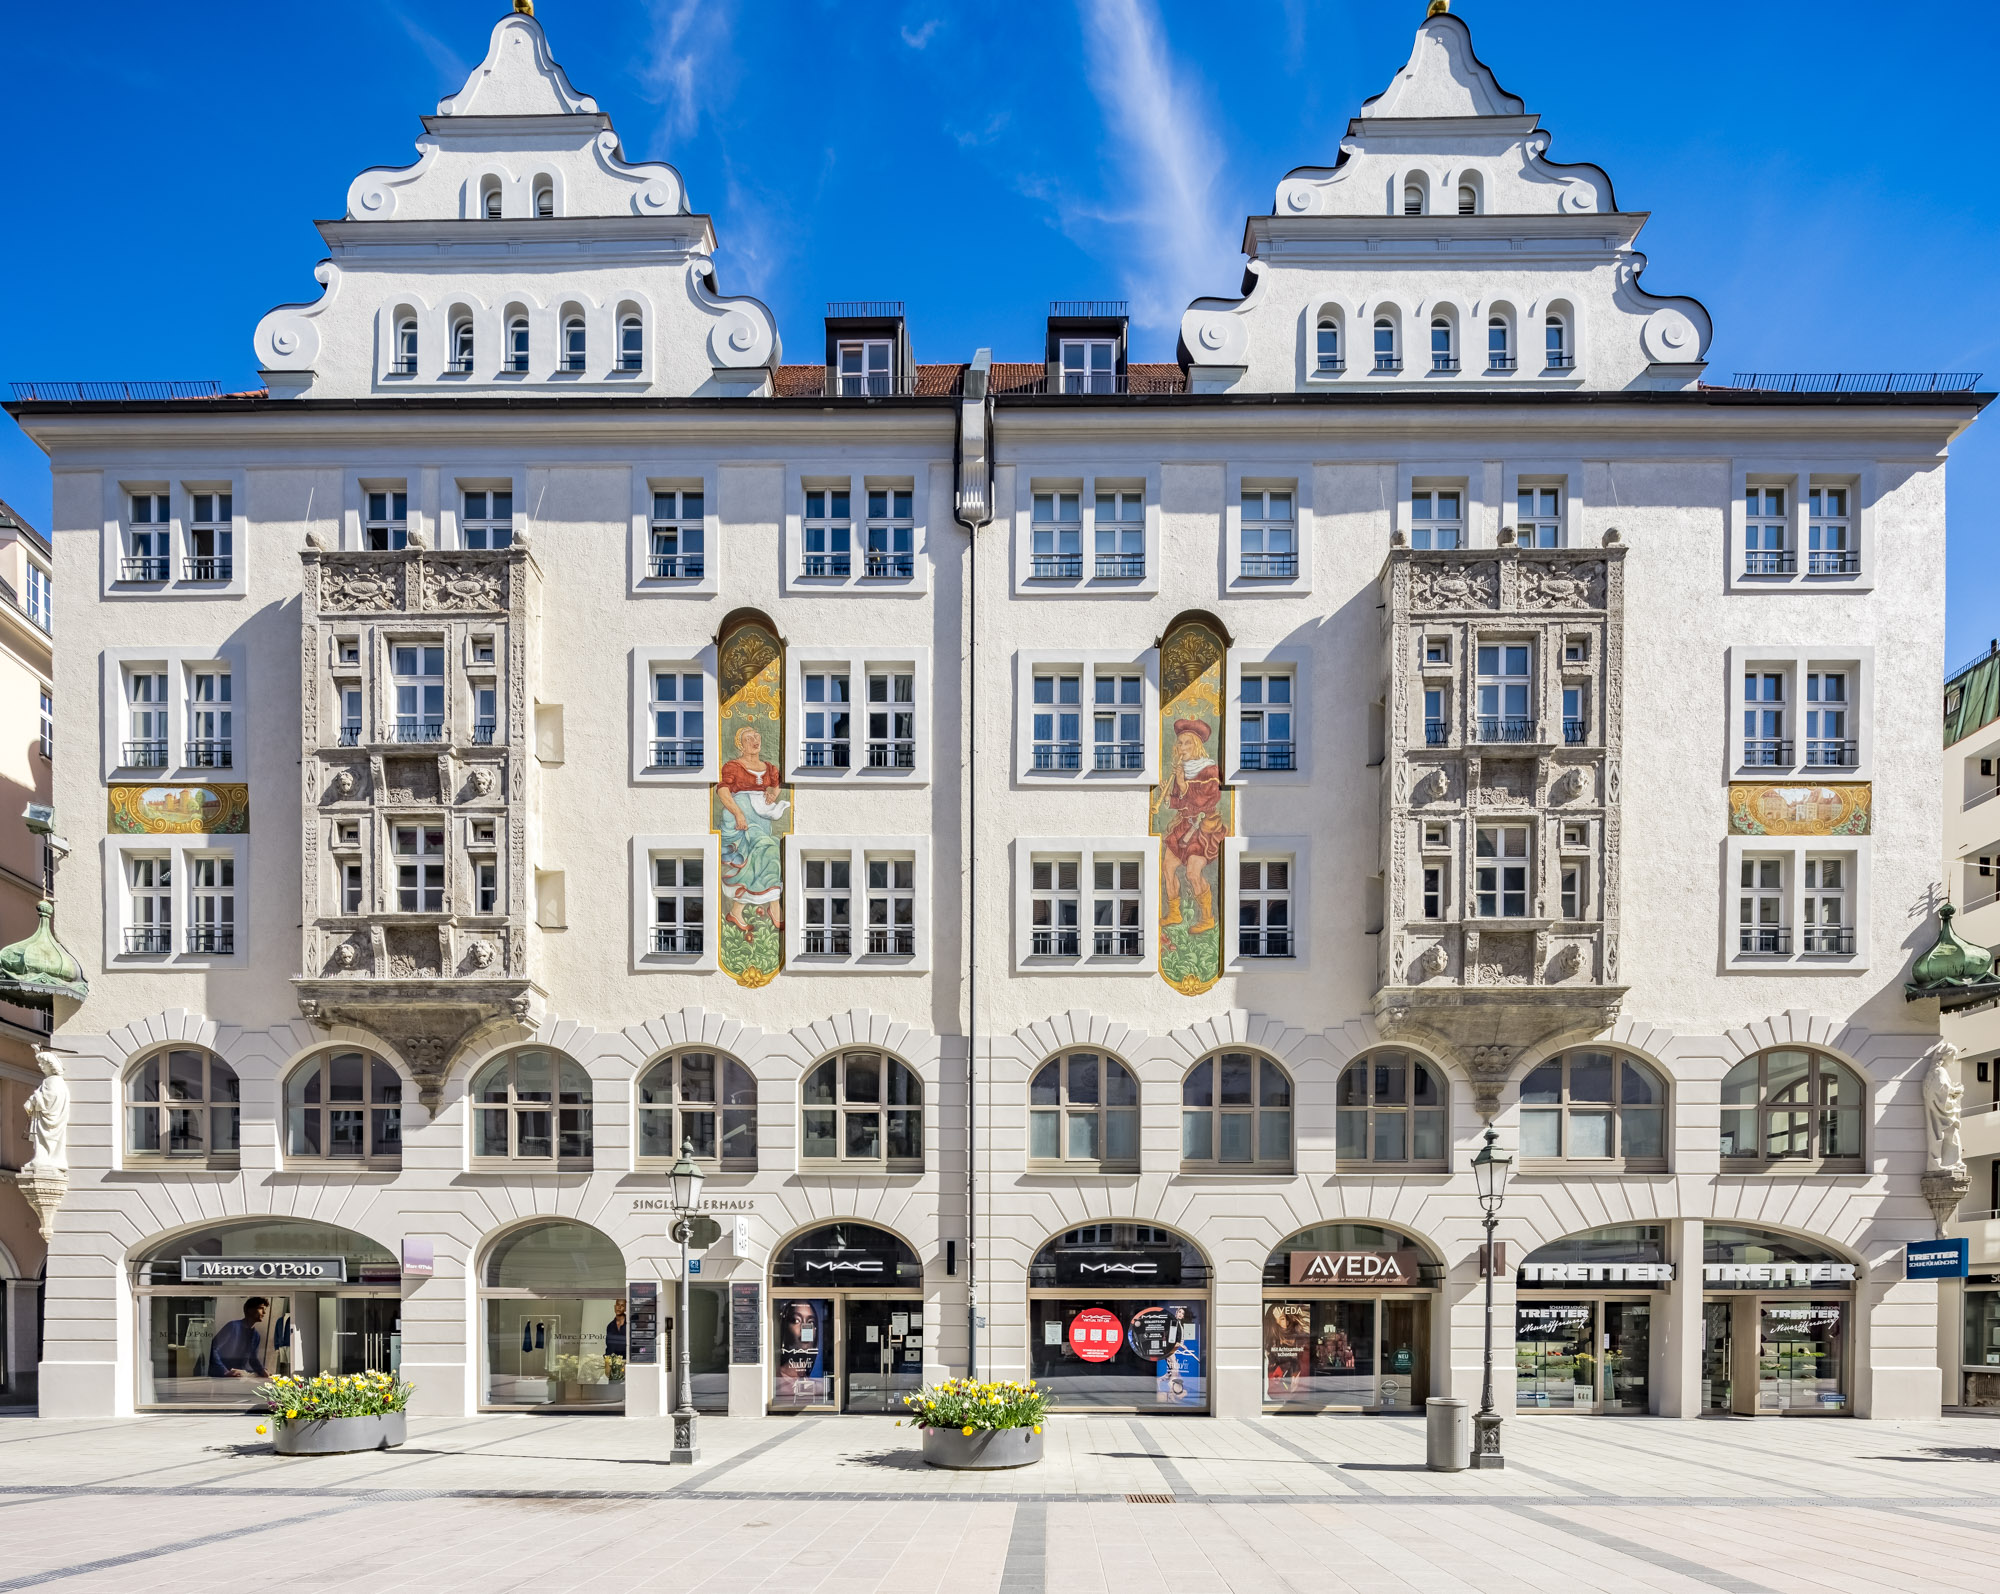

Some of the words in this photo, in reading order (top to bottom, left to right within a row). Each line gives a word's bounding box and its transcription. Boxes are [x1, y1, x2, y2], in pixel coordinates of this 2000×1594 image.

[633, 1199, 754, 1210] SINGLSLERHAUS
[1908, 1251, 1959, 1262] TRETTER
[201, 1262, 255, 1276] Marc
[259, 1262, 324, 1276] O'Polo
[1307, 1255, 1402, 1276] AVEDA
[1520, 1263, 1673, 1281] TRETTER
[1703, 1263, 1857, 1281] TRETTER
[1273, 1306, 1303, 1314] AVEDA
[1519, 1309, 1589, 1318] TRETTER
[1770, 1309, 1840, 1319] TRETTER
